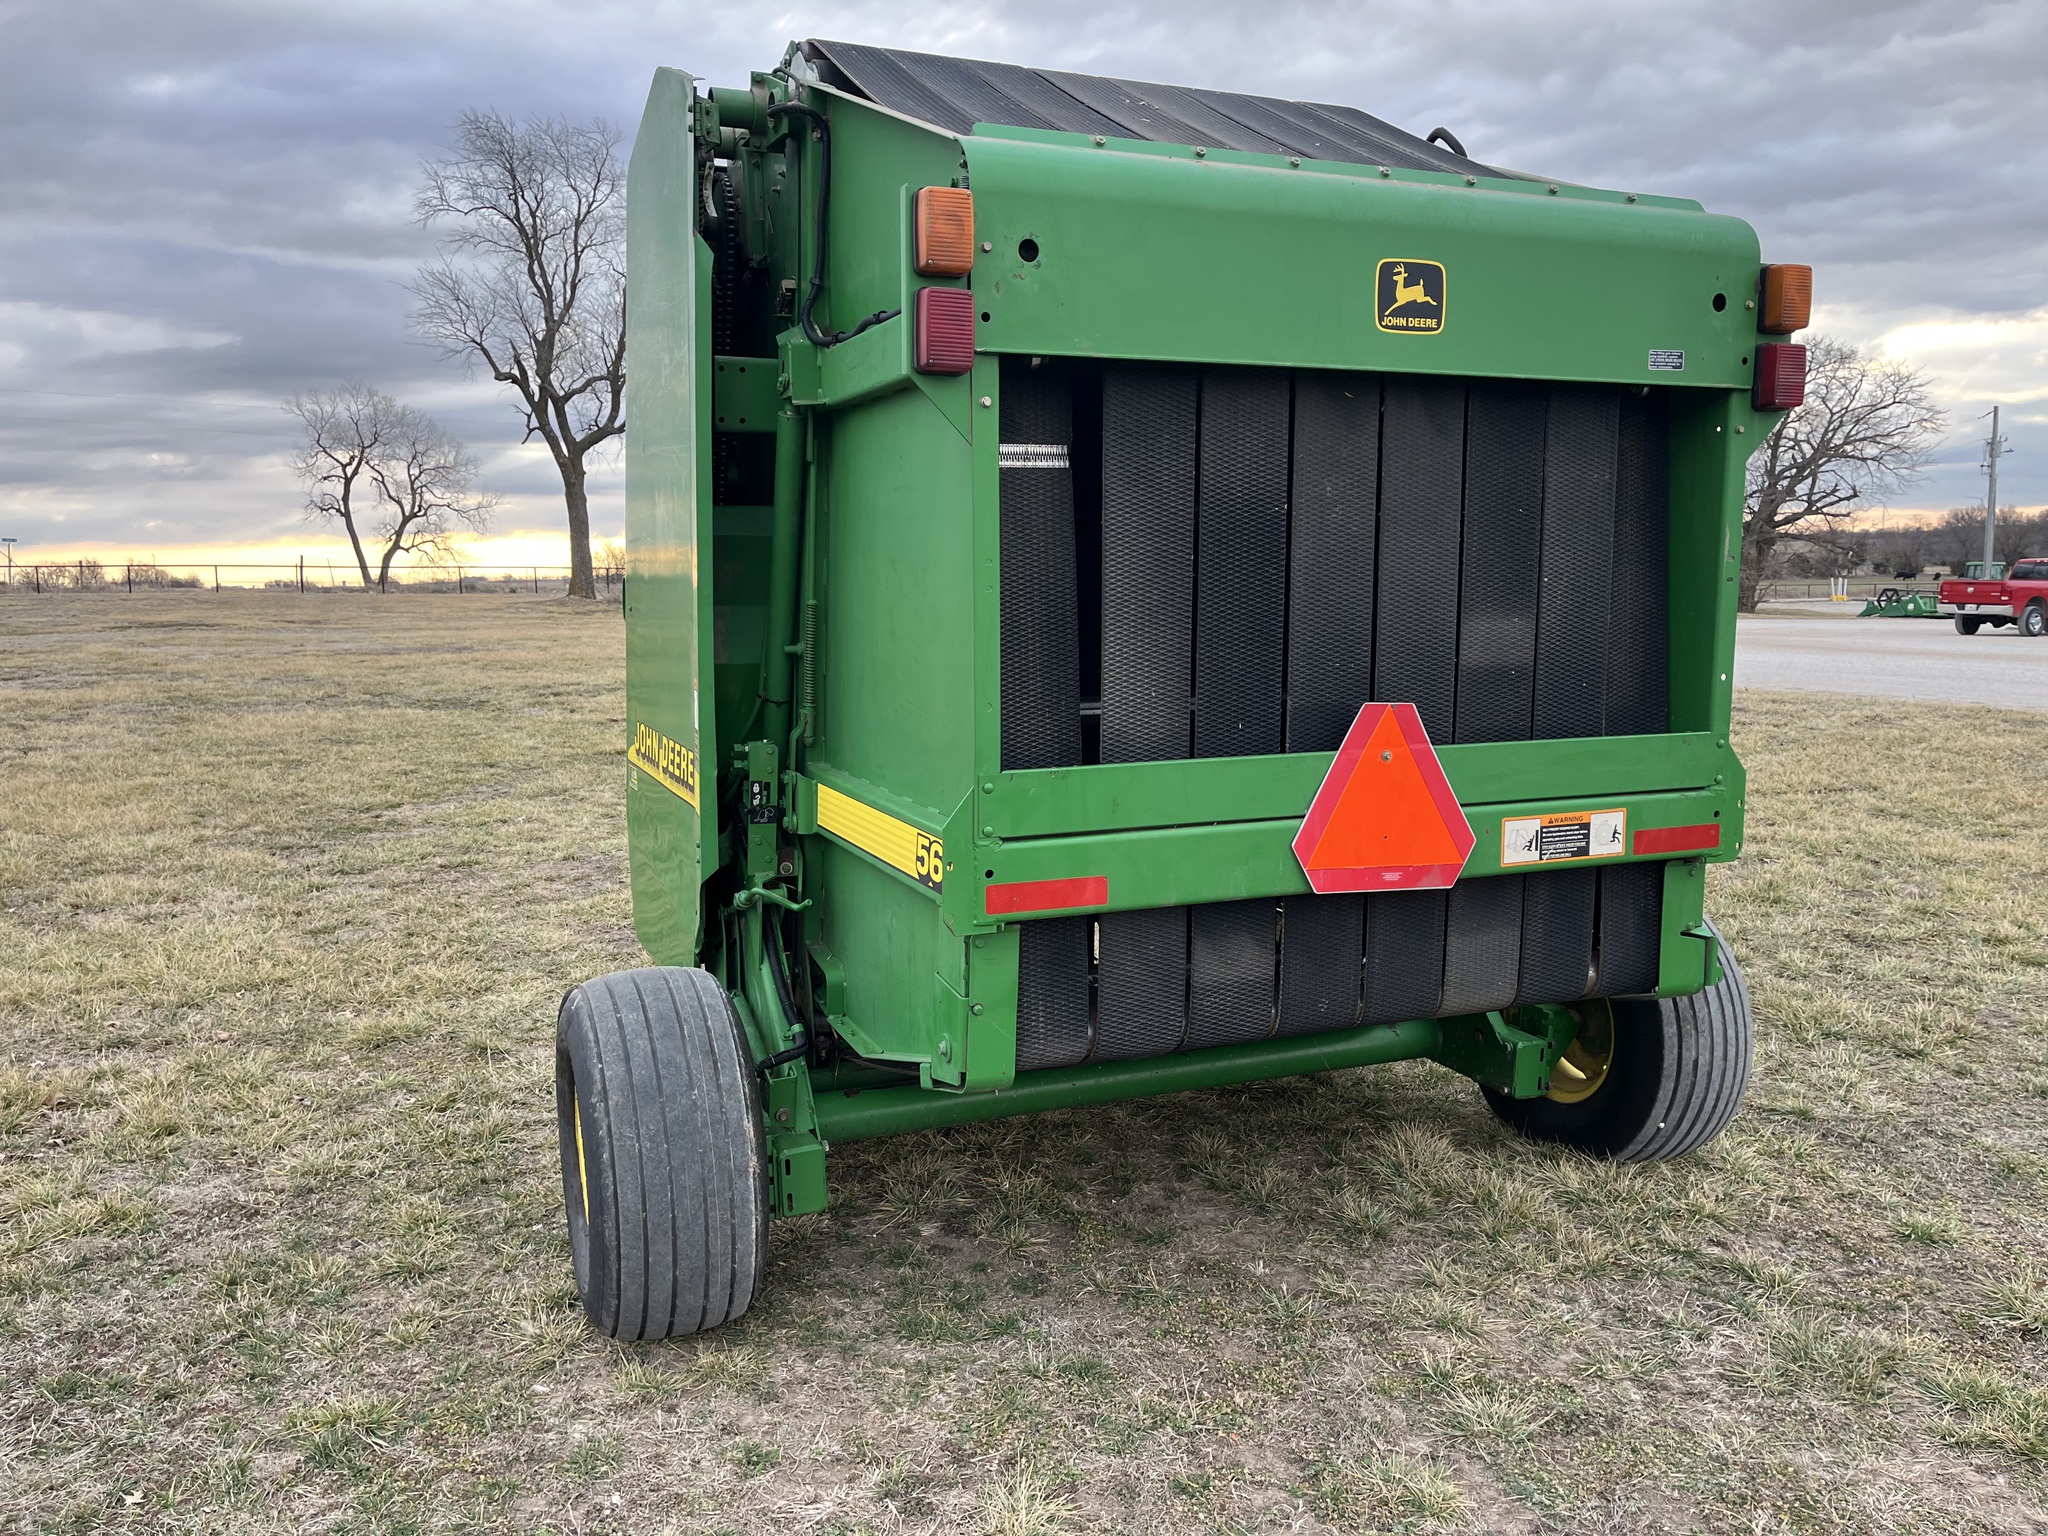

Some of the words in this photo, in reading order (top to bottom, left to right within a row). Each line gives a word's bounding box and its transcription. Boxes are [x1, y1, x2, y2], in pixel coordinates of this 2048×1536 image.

[1381, 316, 1407, 327] JOHN
[1408, 317, 1438, 328] DEERE
[634, 721, 660, 763] JOHN
[662, 735, 695, 787] DEERE
[1554, 815, 1584, 824] WARNING
